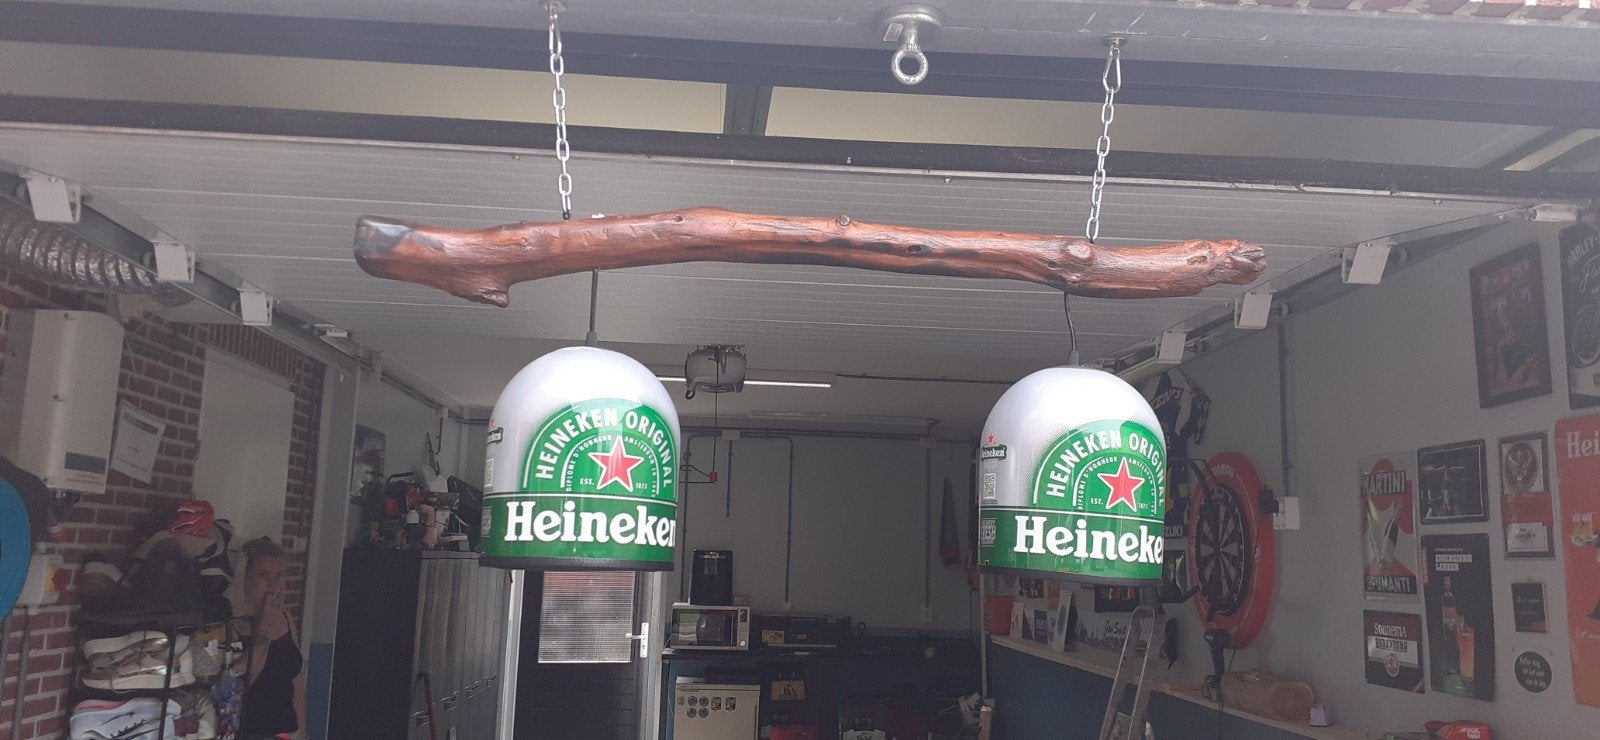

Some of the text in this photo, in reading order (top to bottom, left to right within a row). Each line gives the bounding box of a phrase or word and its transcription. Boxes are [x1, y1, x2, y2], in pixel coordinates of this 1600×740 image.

[535, 407, 673, 488] HEINEKEN ORIGINAL
[1566, 430, 1600, 458] Hei
[579, 478, 595, 486] EST.
[1046, 429, 1123, 498] HEINEKEN
[1129, 432, 1165, 507] ORIGINAL
[1359, 470, 1405, 495] MARTINI
[1090, 497, 1104, 505] EST.
[504, 500, 676, 548] Heineken
[1014, 515, 1164, 565] Heineke
[1366, 576, 1410, 593] SPUMANTI
